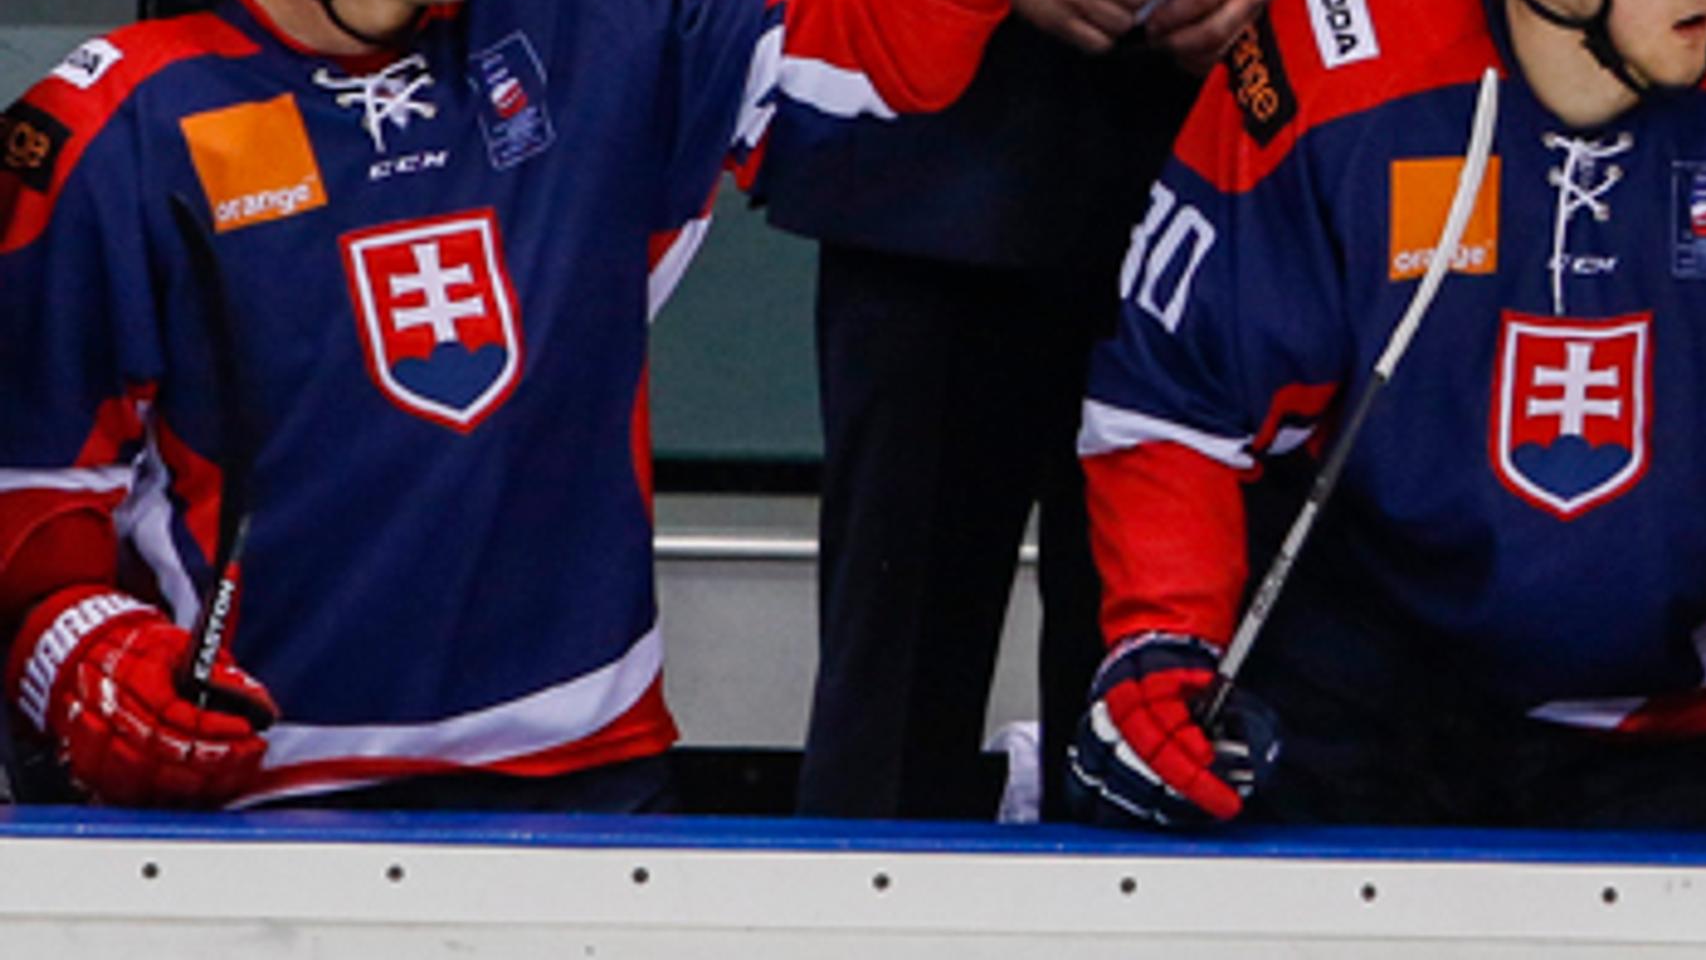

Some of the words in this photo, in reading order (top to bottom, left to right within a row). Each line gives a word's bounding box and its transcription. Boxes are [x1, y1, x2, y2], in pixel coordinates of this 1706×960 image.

[367, 150, 450, 181] CCM
[214, 183, 312, 222] orange
[194, 578, 237, 680] EASTON
